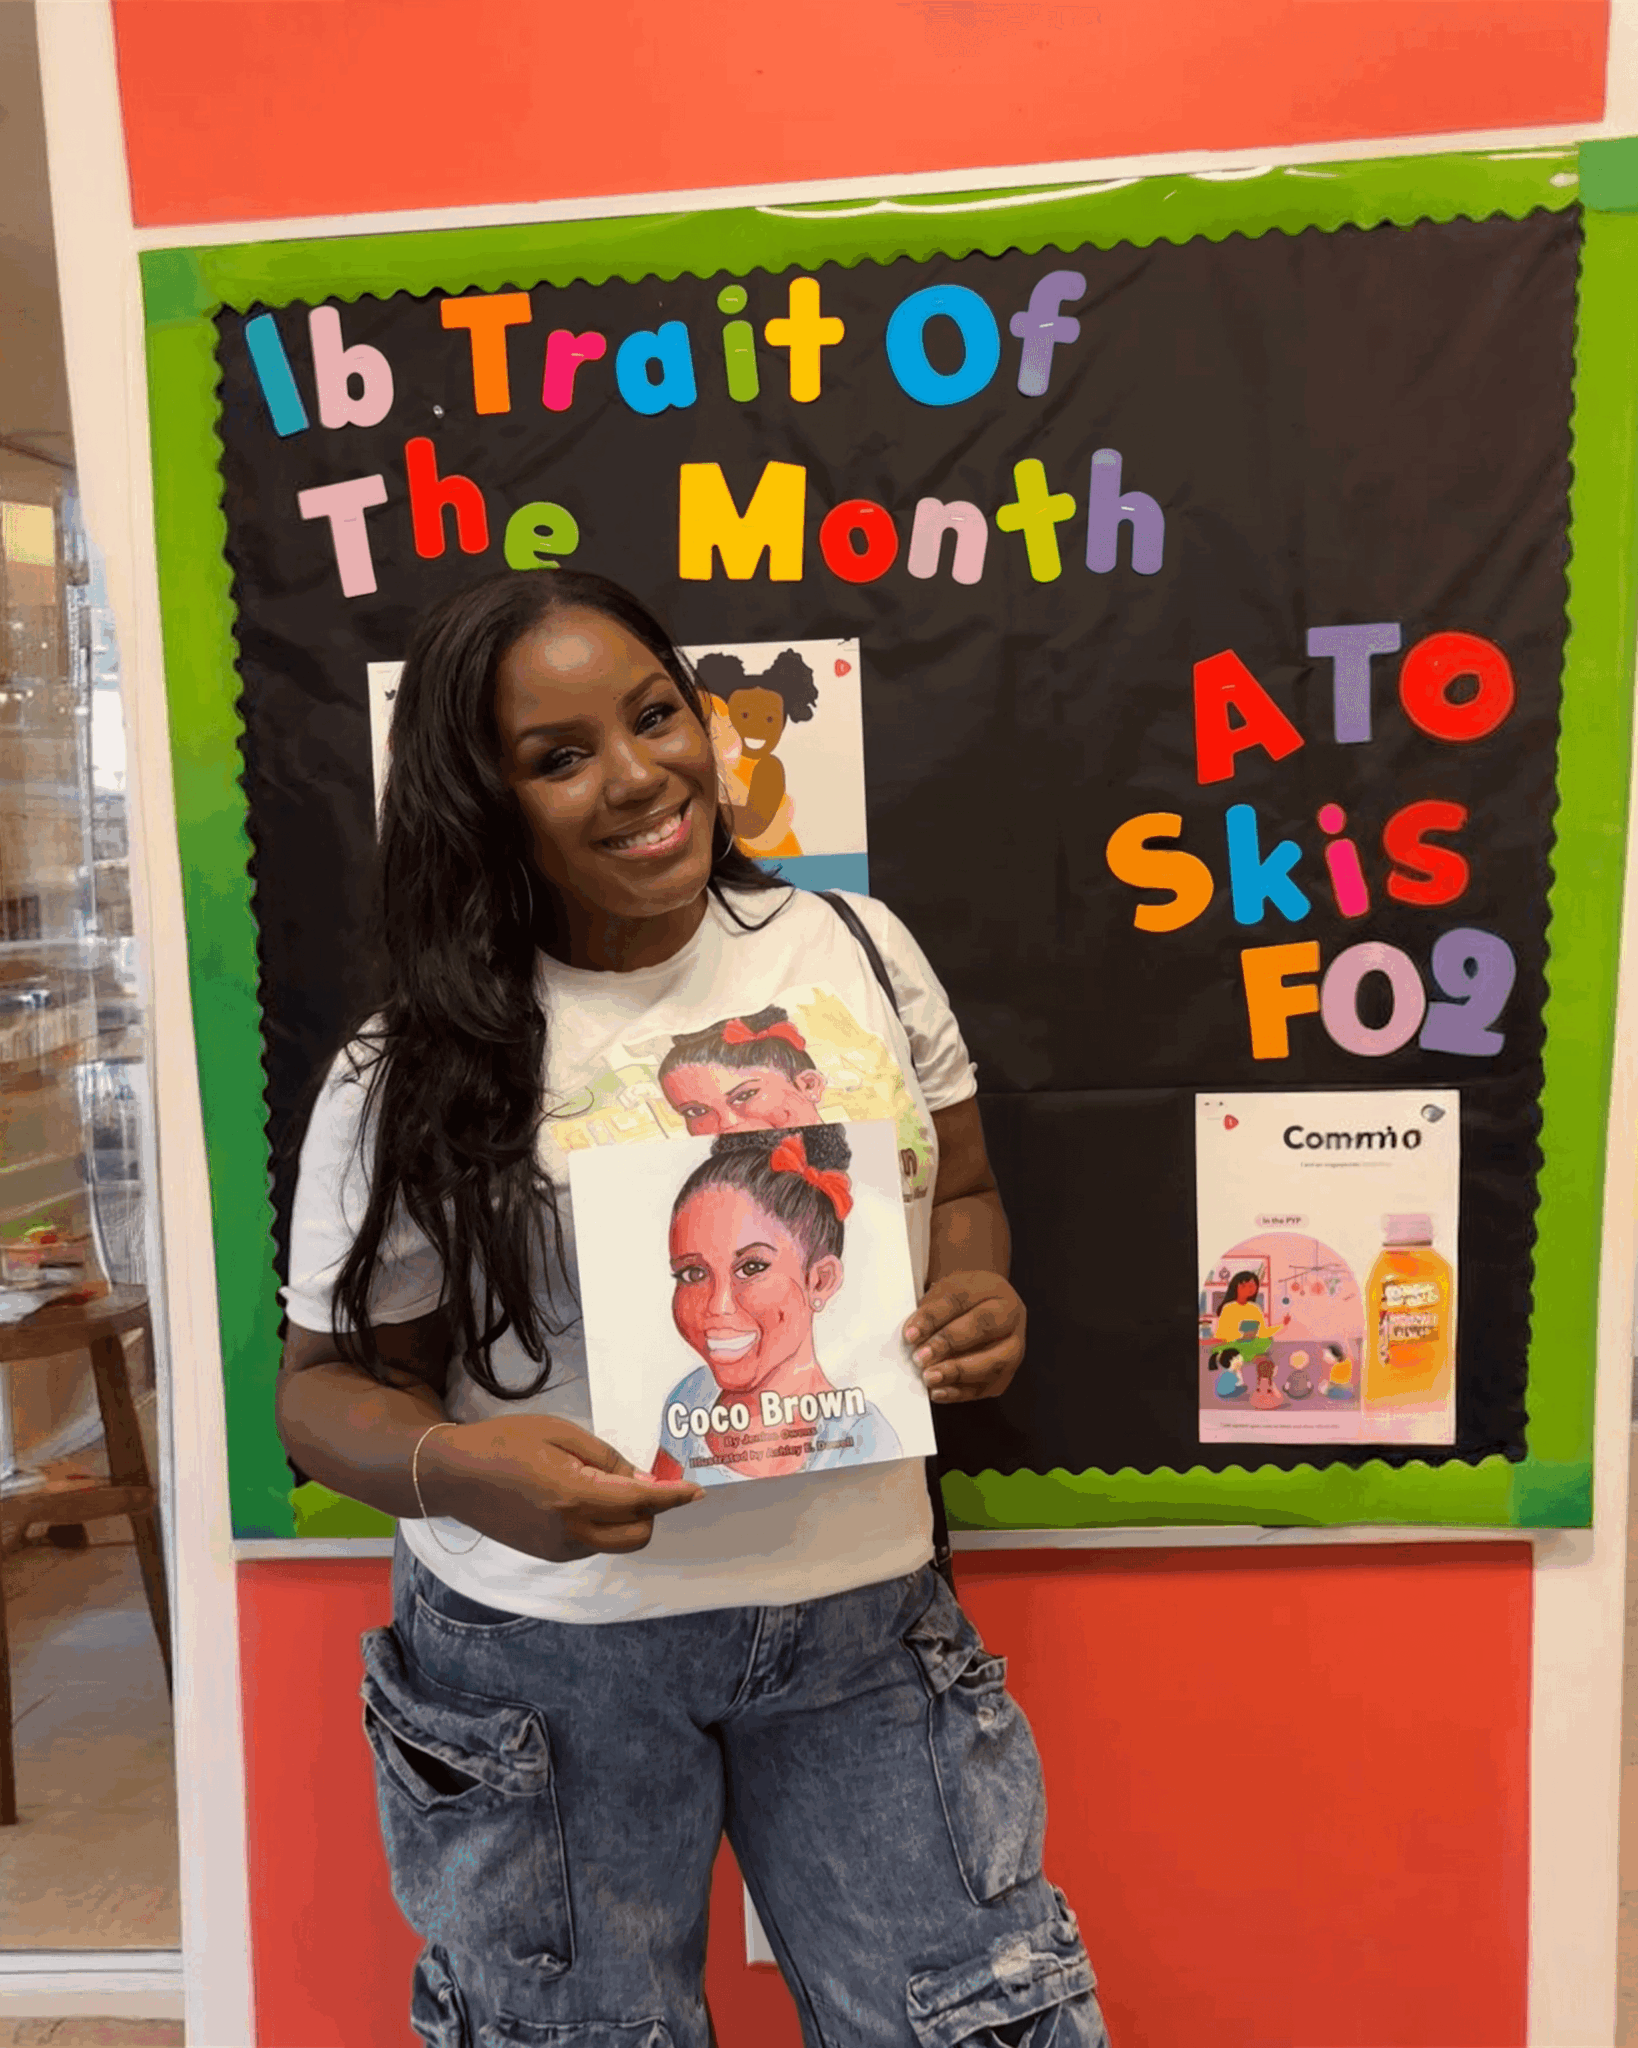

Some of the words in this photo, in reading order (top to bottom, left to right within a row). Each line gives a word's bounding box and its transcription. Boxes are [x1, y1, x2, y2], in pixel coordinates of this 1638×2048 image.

[440, 277, 846, 416] Trait
[886, 270, 1087, 406] Of
[298, 436, 580, 598] The
[678, 448, 1166, 585] Month
[666, 1401, 750, 1439] Coco
[760, 1386, 866, 1426] Brown
